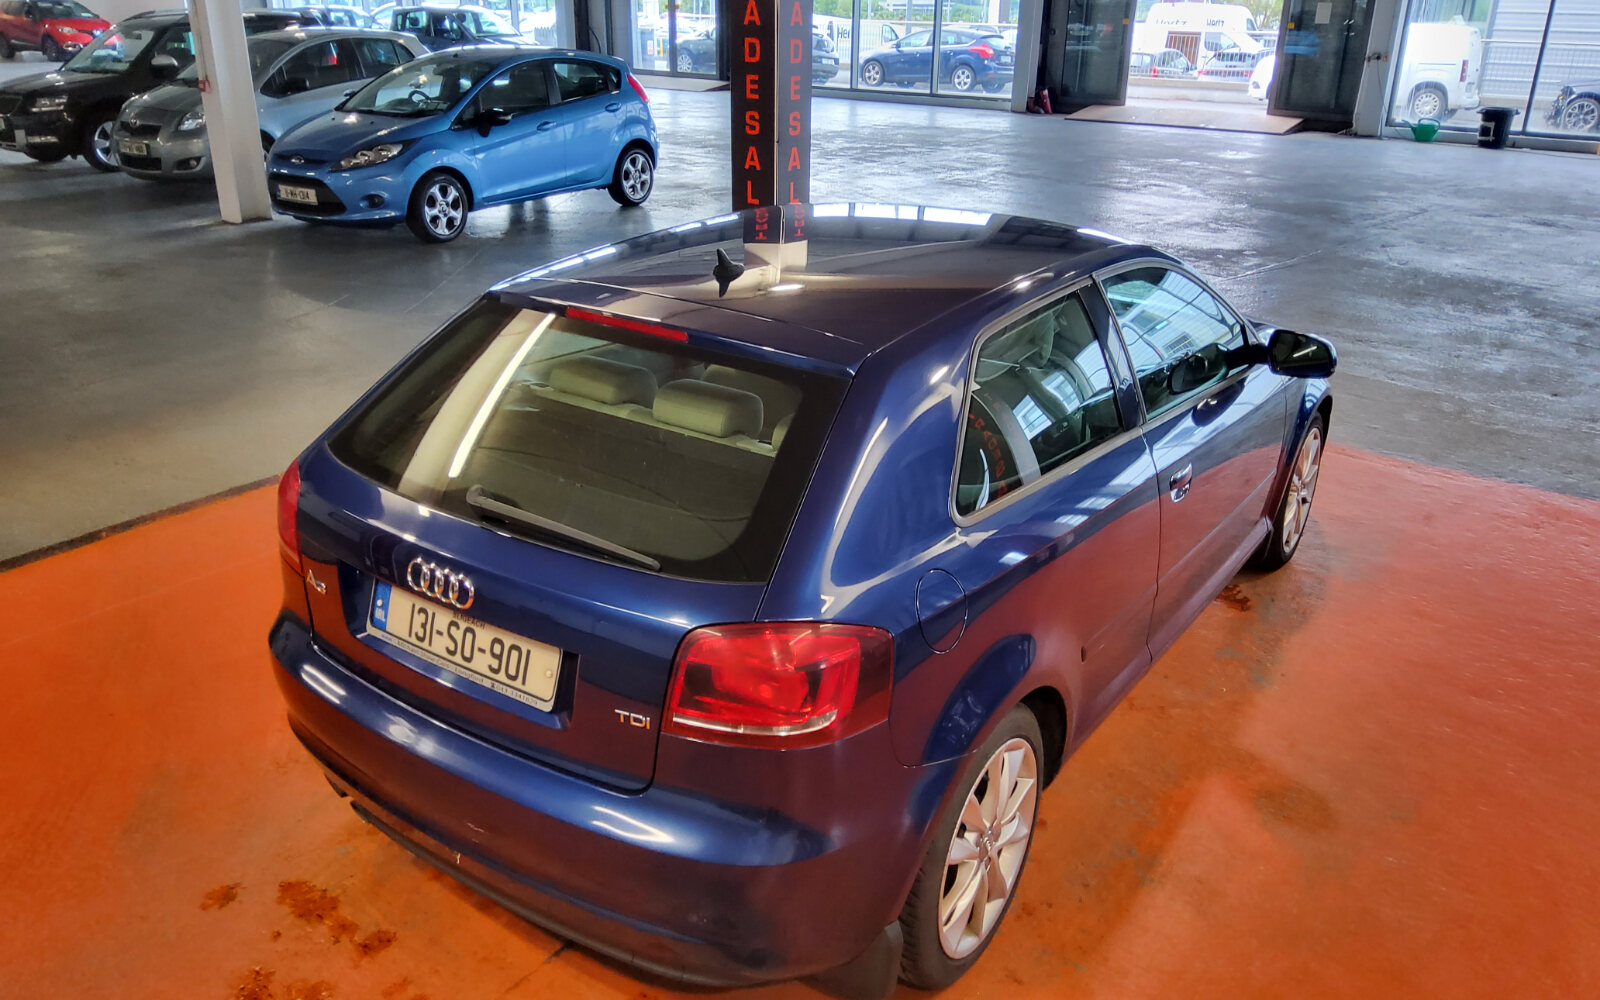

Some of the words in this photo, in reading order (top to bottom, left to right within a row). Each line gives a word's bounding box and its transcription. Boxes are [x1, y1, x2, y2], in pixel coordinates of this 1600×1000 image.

[307, 568, 326, 594] A3
[408, 603, 531, 686] 131-SO-901
[614, 708, 651, 730] TDI
